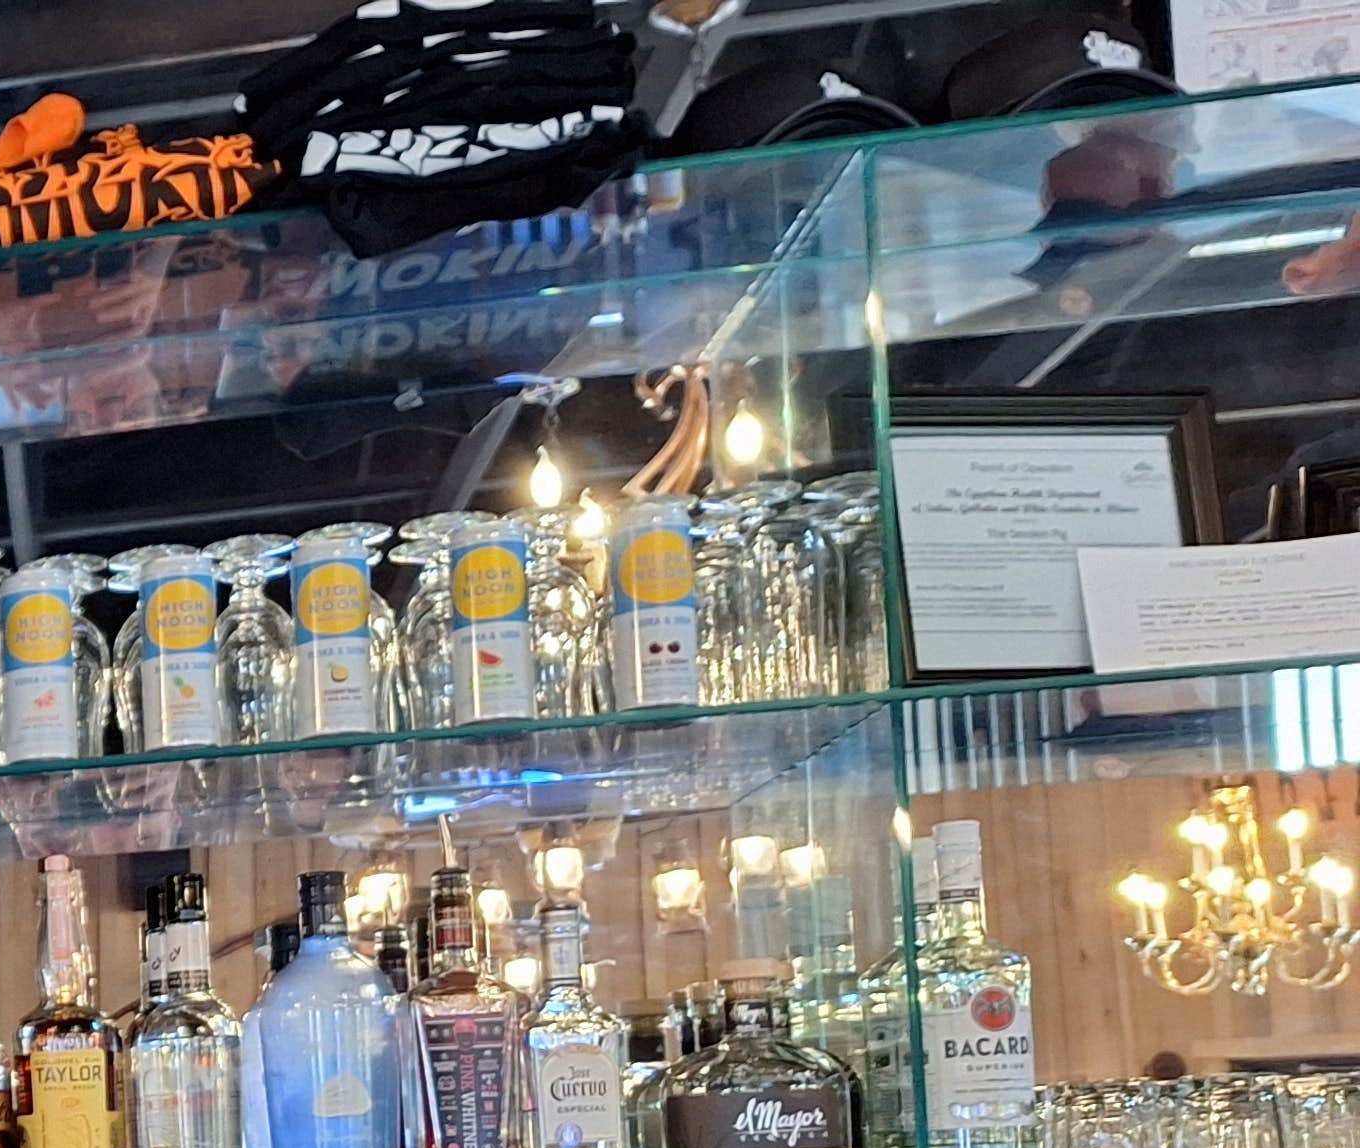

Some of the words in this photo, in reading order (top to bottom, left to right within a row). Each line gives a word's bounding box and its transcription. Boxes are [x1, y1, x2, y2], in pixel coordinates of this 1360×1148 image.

[36, 1065, 102, 1083] TAYLOR
[460, 1053, 475, 1091] PINK
[550, 1077, 607, 1102] Cuervo
[556, 1103, 607, 1114] ESPECIAL
